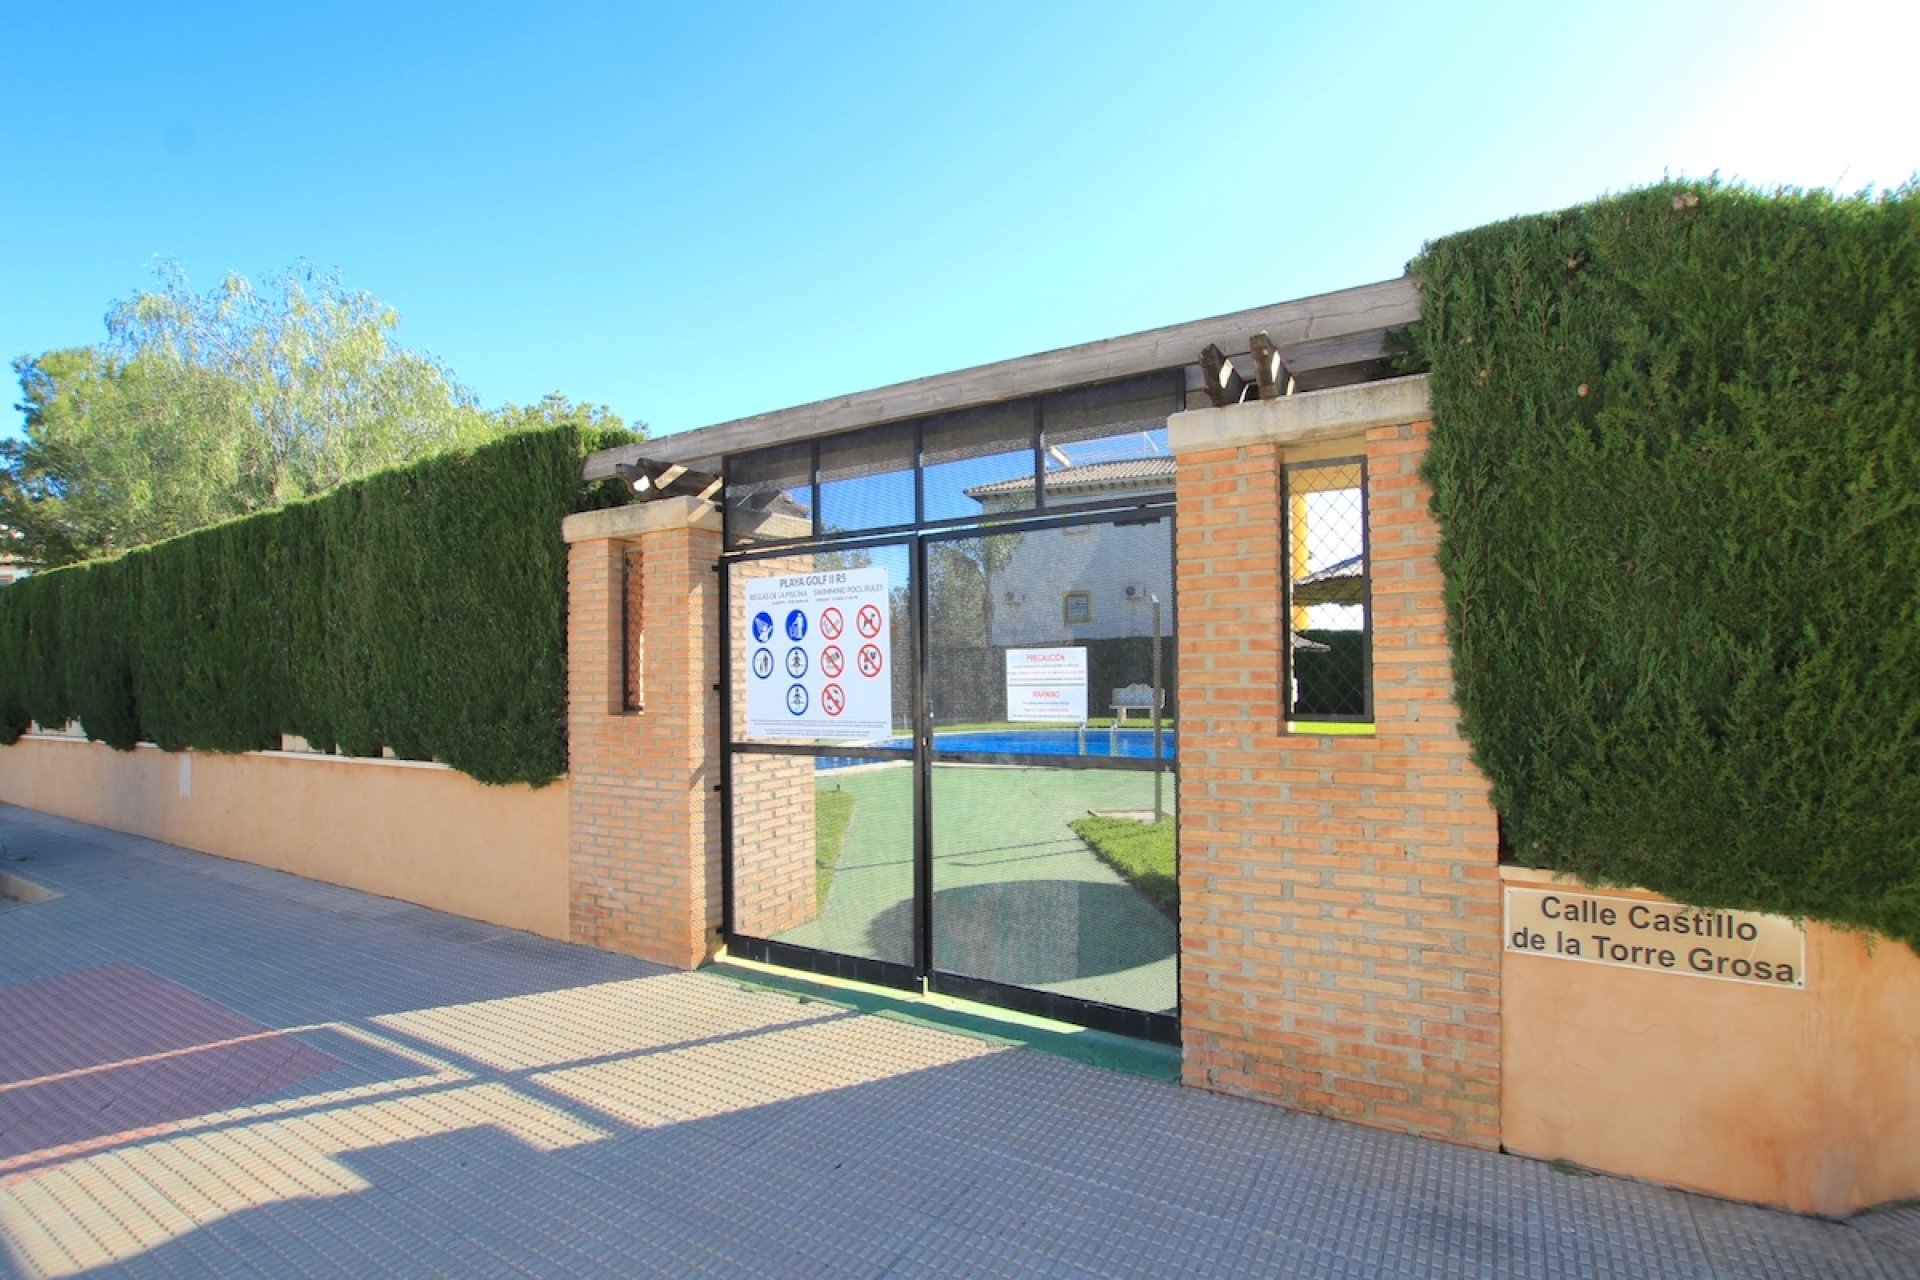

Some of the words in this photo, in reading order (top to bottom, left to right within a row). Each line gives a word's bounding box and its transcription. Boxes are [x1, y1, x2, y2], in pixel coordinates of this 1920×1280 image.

[779, 577, 805, 588] PLAYA
[806, 574, 828, 586] GOLF
[750, 592, 770, 601] REGLAS
[770, 592, 777, 600] DE
[778, 591, 785, 599] LA
[785, 590, 808, 598] PISCINA
[814, 587, 847, 596] SWIMMING
[847, 585, 863, 593] POOL
[864, 584, 884, 592] RULES
[1541, 896, 1617, 925] Calle
[1628, 906, 1757, 941] Castillo
[1512, 927, 1546, 950] de
[1556, 931, 1581, 955] la
[1592, 935, 1677, 967] Torre
[1688, 947, 1794, 982] Grosa
